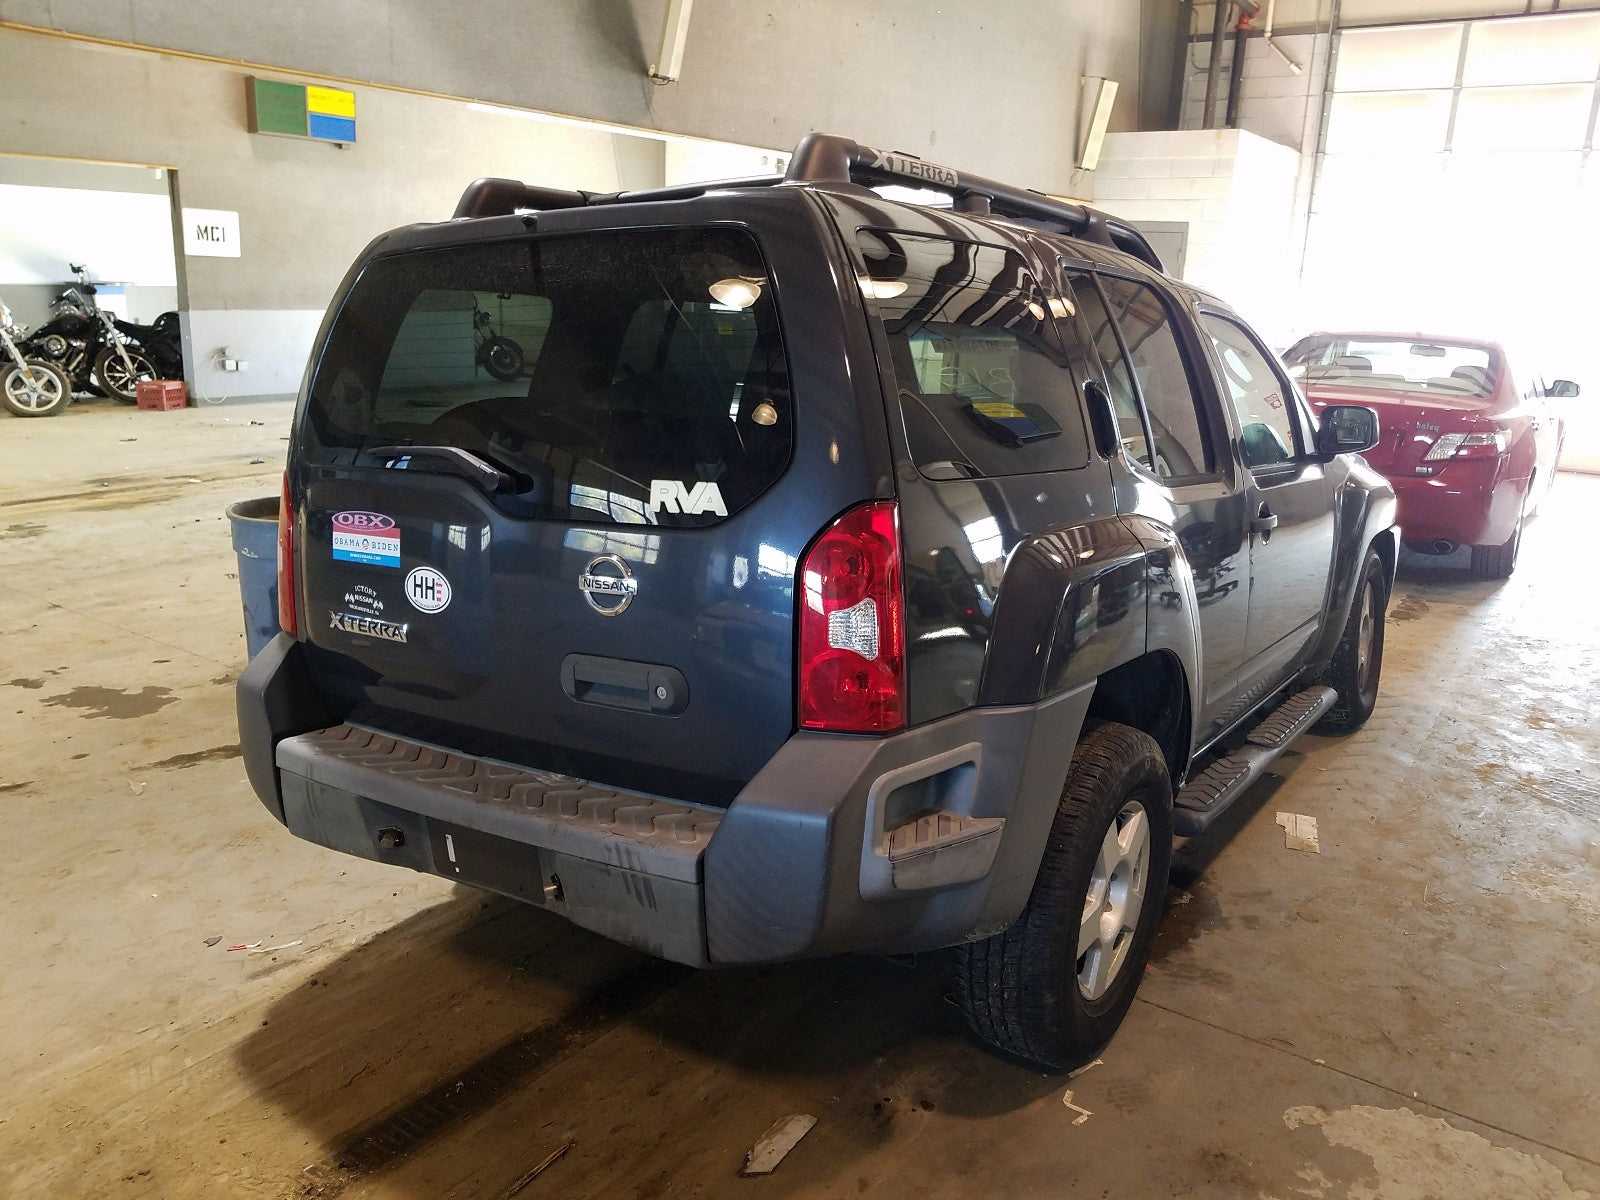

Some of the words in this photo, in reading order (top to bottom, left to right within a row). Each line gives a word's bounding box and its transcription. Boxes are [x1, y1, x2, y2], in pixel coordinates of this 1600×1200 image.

[868, 148, 959, 188] XTERRA
[650, 479, 728, 517] RVA
[338, 513, 386, 528] OBX
[334, 537, 360, 547] OBAMA
[371, 541, 399, 552] BIDEN
[583, 578, 629, 592] NISSAN
[329, 610, 408, 643] XTERRA
